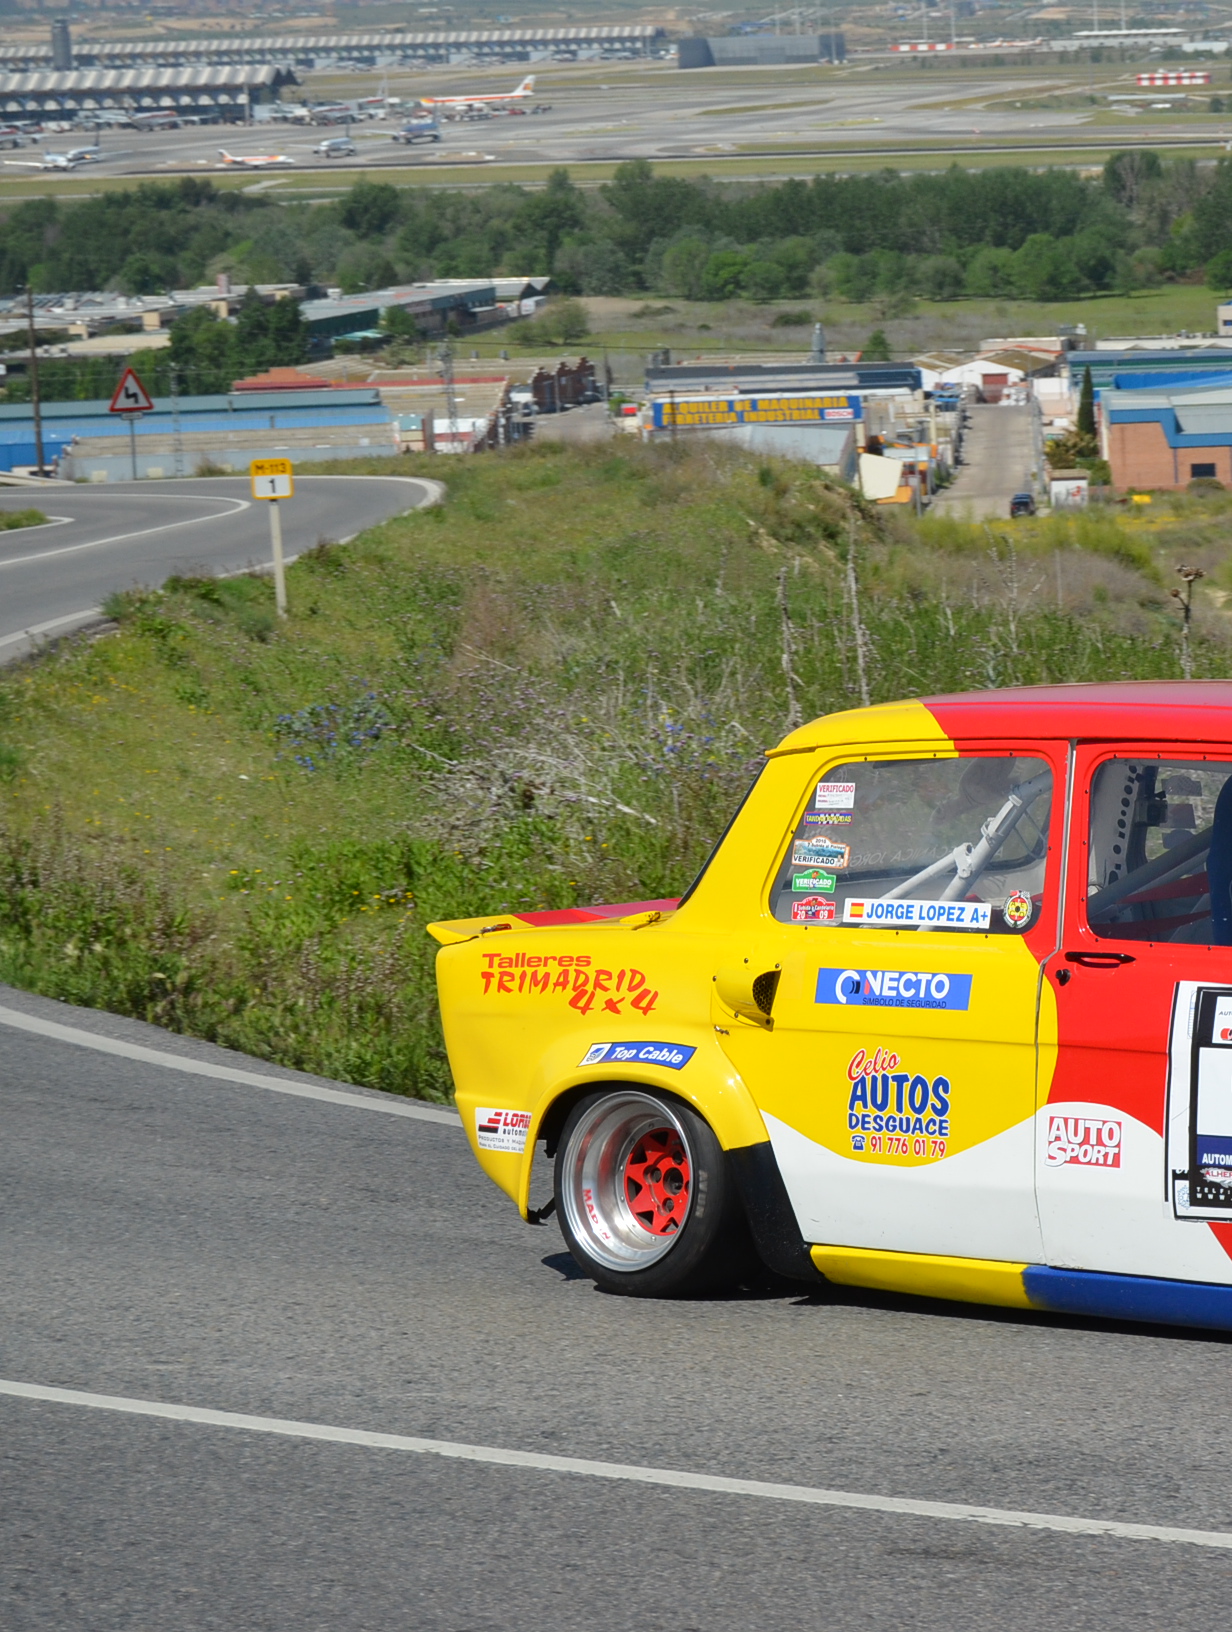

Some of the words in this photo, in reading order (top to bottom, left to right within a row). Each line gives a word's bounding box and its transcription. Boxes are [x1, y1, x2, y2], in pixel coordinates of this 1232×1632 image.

[757, 396, 849, 411] MAQUINARIA
[662, 411, 738, 426] FRRETERIA
[743, 409, 821, 422] INDUSTRIAL
[255, 462, 287, 474] M-113
[268, 478, 276, 493] 1
[819, 784, 854, 793] VERIFICADO
[794, 855, 835, 865] VERIFICADO
[796, 878, 832, 886] VERIFICADO
[866, 903, 915, 920] JORGE
[918, 905, 966, 922] LOPEZ
[970, 908, 988, 923] A+
[482, 952, 592, 969] Talleres
[481, 968, 646, 995] TRIMADRID
[568, 987, 659, 1016] 4x4
[895, 998, 905, 1007] DE
[905, 998, 947, 1009] SEGURIDAD
[611, 1046, 637, 1060] Top
[638, 1046, 684, 1064] Cable
[847, 1047, 900, 1081] Celio
[848, 1073, 950, 1118] AUTOS
[848, 1112, 949, 1137] DESGUACE
[1048, 1117, 1121, 1147] AUTO
[870, 1136, 882, 1153] 91
[887, 1136, 908, 1155] 776
[913, 1138, 926, 1156] 01
[931, 1140, 946, 1157] 79
[1044, 1141, 1119, 1167] SPORT
